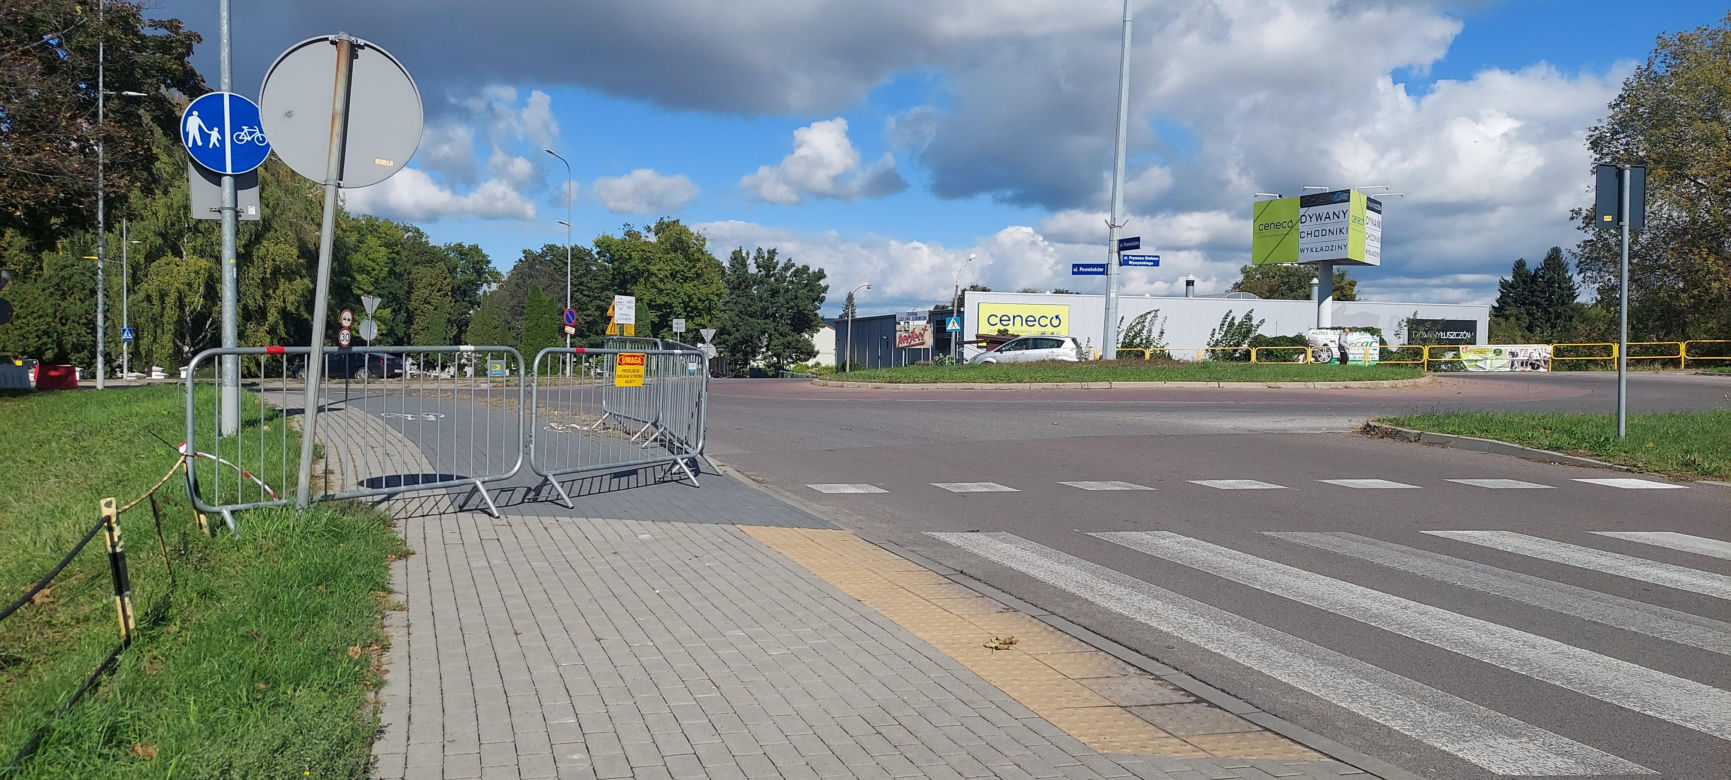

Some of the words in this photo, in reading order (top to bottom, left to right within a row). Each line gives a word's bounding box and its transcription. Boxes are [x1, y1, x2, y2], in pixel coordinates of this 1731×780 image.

[1300, 209, 1348, 224] DYWANY
[1258, 219, 1293, 231] ceneco
[1300, 226, 1348, 239] CHODNIKI
[1300, 243, 1348, 254] WYKŁADZINY
[987, 313, 1062, 328] ceneco
[341, 332, 349, 342] 30
